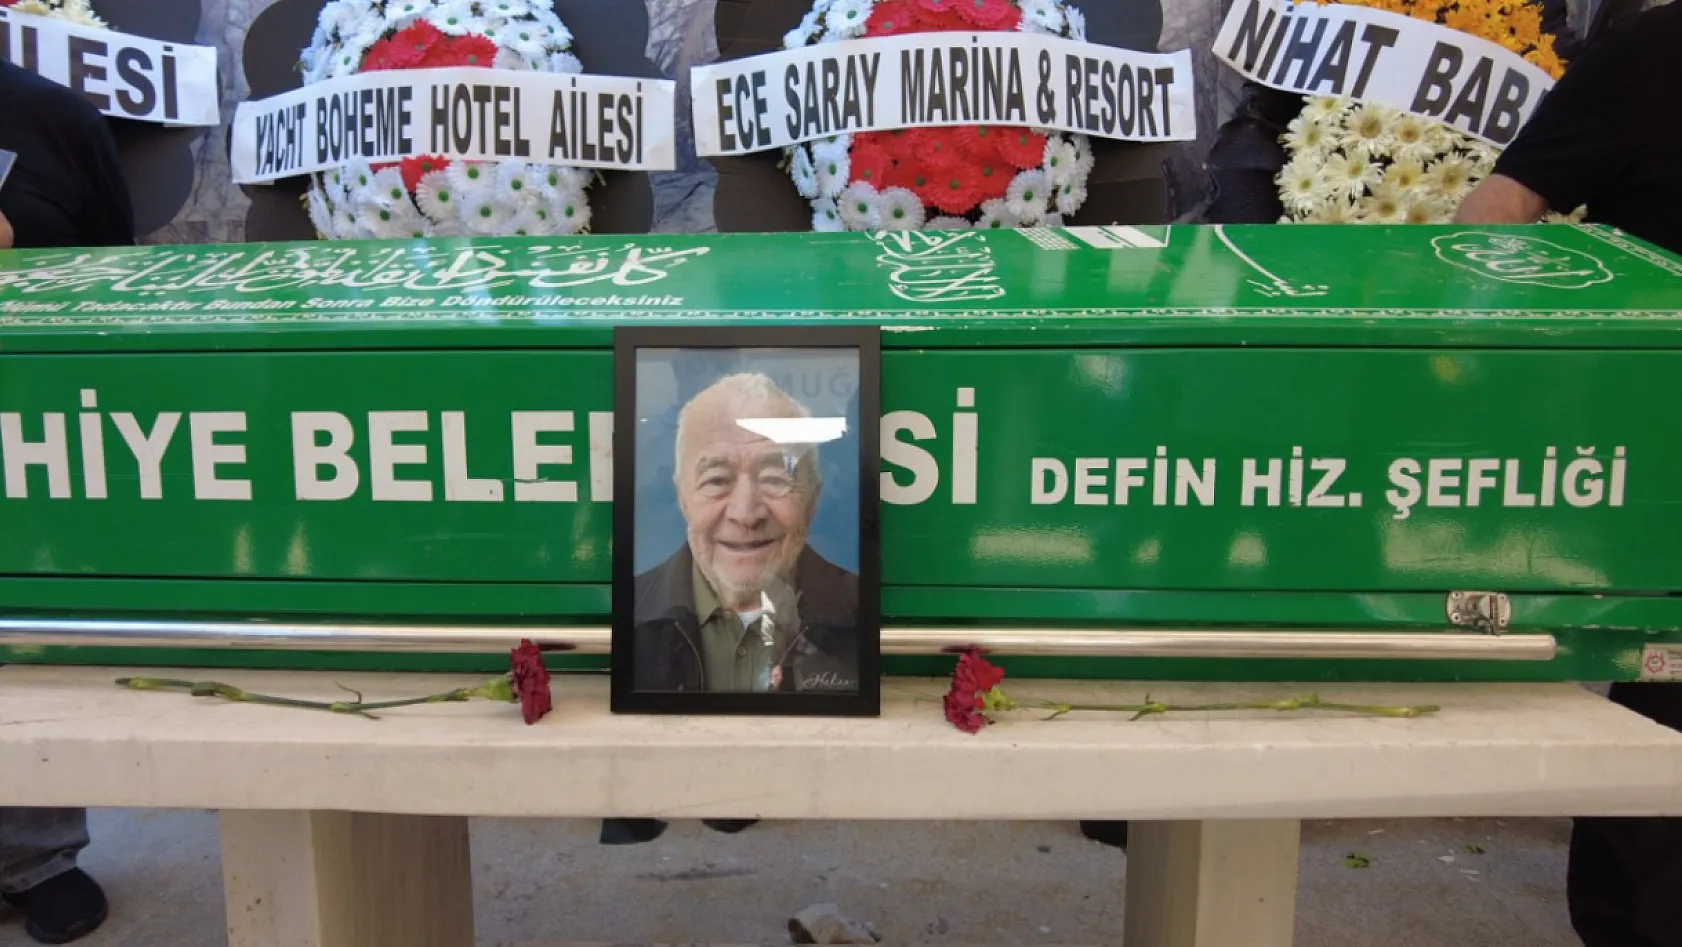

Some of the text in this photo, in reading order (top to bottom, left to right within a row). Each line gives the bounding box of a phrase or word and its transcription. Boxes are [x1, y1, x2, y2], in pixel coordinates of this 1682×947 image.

[256, 77, 642, 175] YACHT BOHEME HOTEL AİLESİ
[717, 36, 1174, 151] ECE SARAY MARİNA & RESORT
[1228, 0, 1549, 145] NİHAT BAB
[301, 296, 375, 309] Sonra
[379, 295, 435, 308] Bize
[0, 388, 252, 500] HİYE
[1032, 446, 1215, 506] DEFİN
[1241, 446, 1362, 507] HİZ.
[1386, 446, 1626, 522] ŞEFLİĞİ
